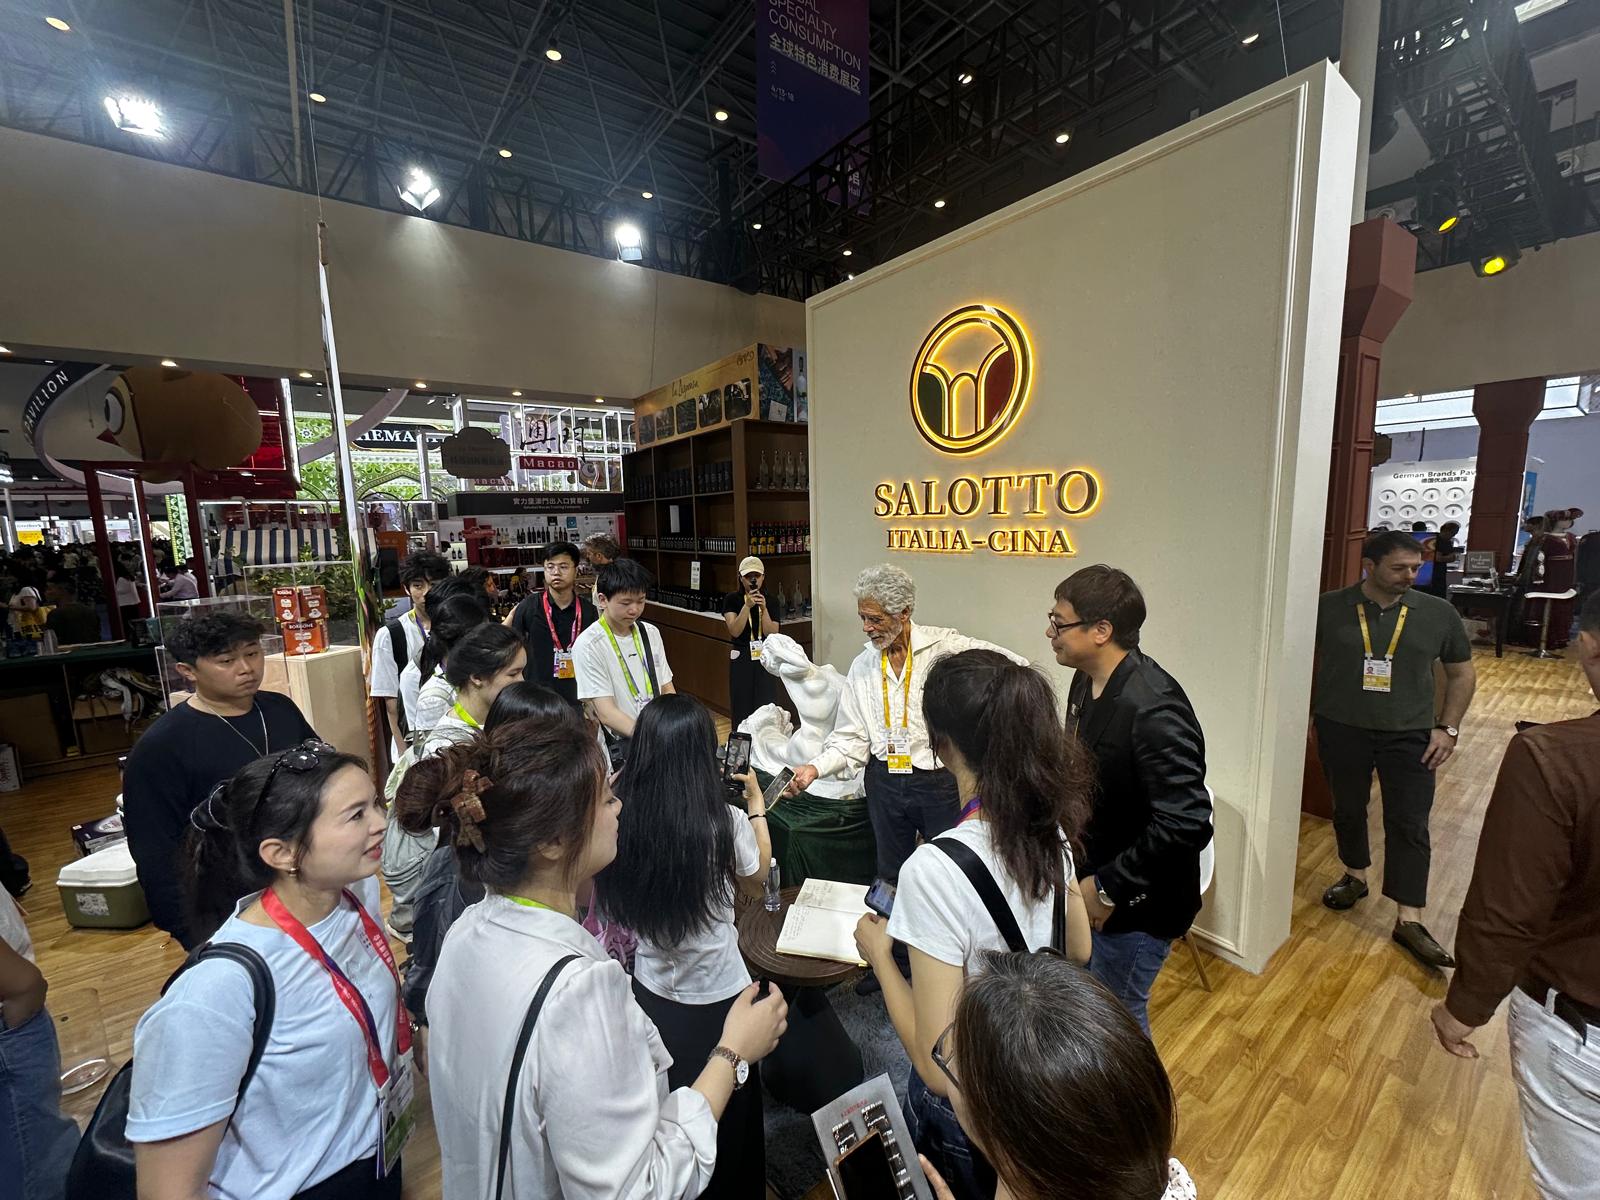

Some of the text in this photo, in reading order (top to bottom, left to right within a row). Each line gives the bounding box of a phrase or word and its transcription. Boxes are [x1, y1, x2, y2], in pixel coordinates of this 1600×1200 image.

[769, 8, 861, 71] CONSUMPTION
[769, 31, 862, 95] 全球特色消费展区
[24, 370, 69, 434] PAVILION
[522, 458, 575, 469] Macao
[874, 470, 1098, 517] SALOTTO
[886, 529, 1074, 553] ITALIA-CINA
